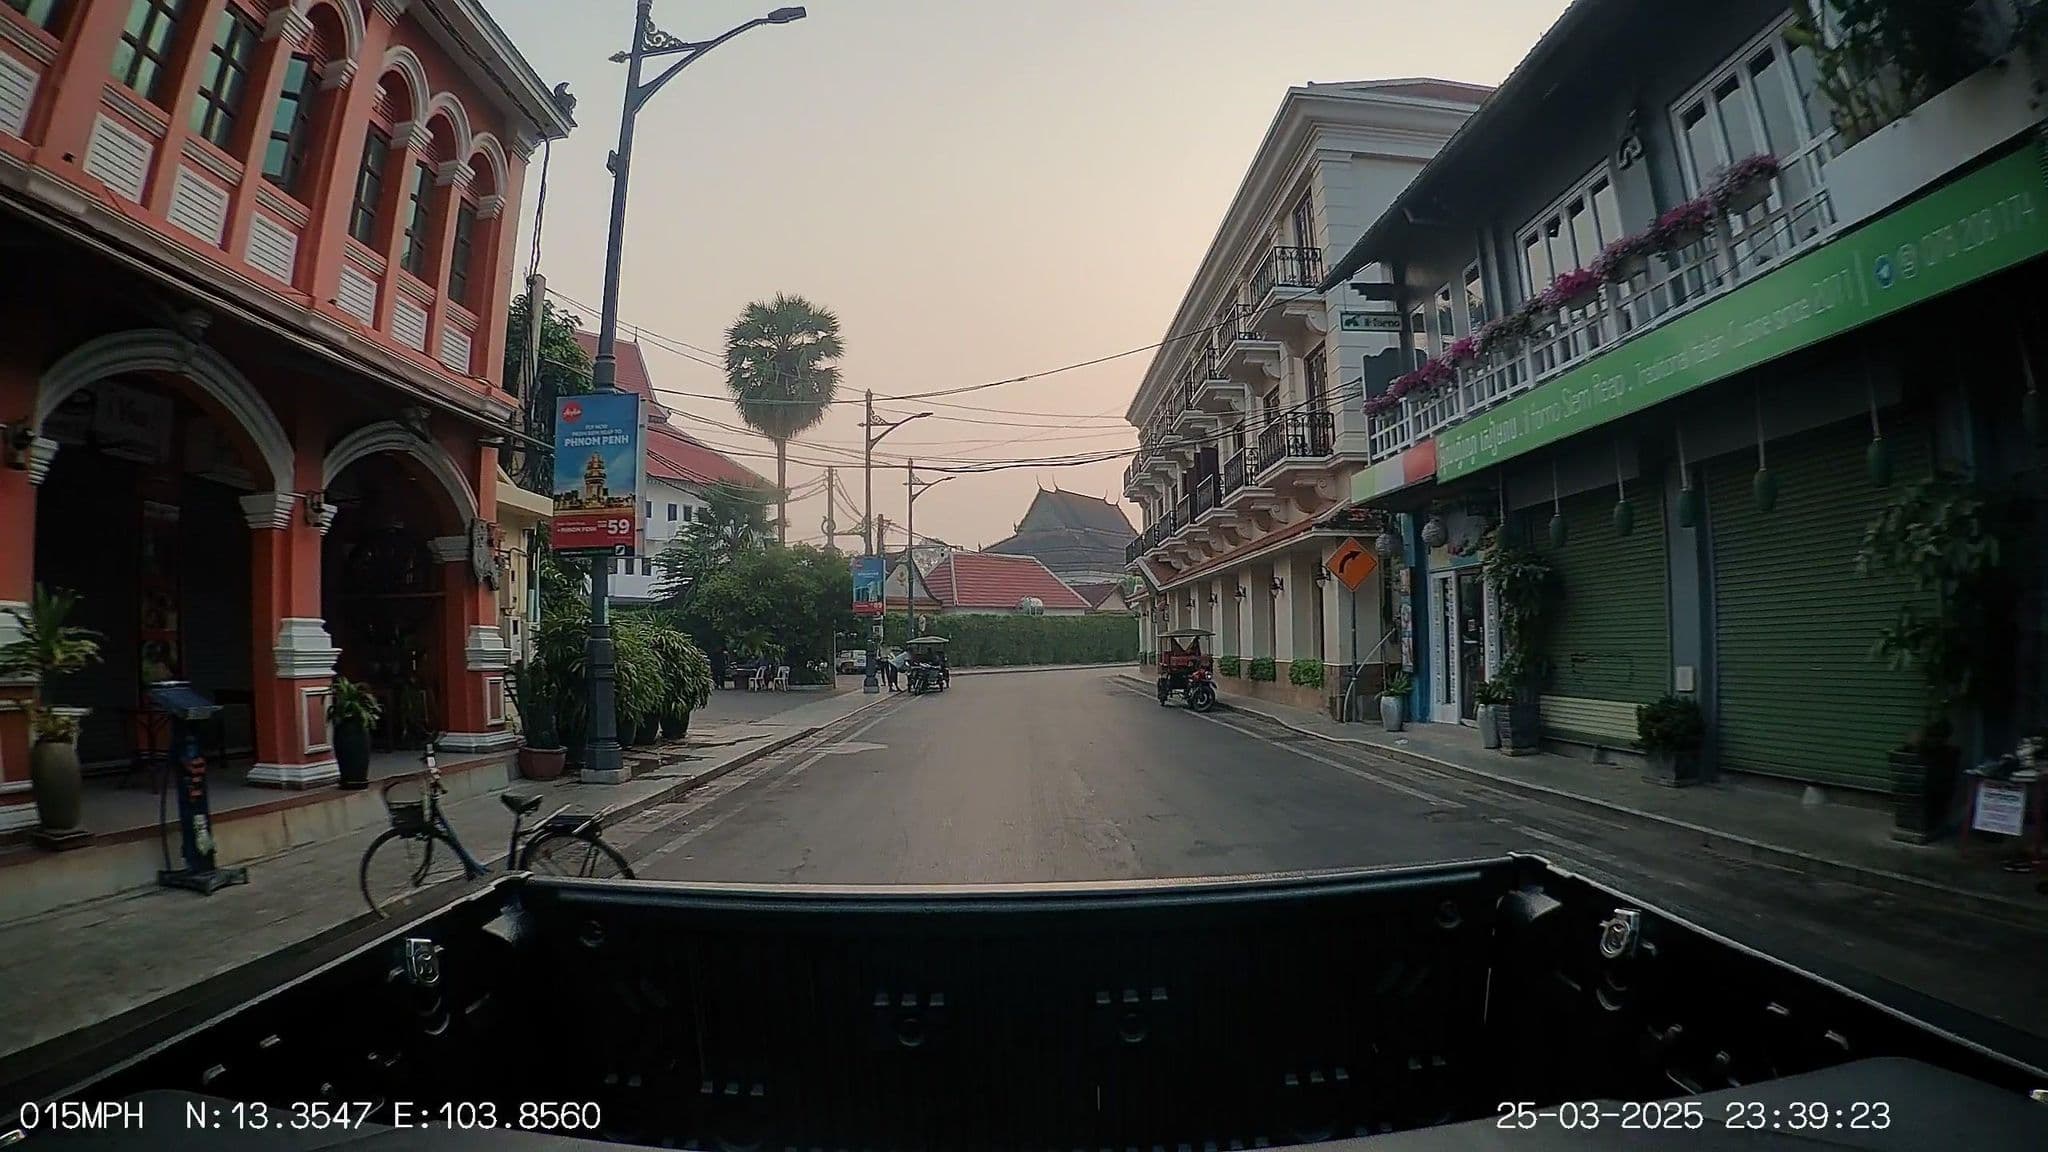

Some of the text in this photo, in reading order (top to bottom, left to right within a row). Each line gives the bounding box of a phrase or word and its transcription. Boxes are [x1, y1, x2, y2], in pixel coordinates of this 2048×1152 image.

[564, 434, 629, 447] PHNOM PENH
[607, 518, 630, 535] 59
